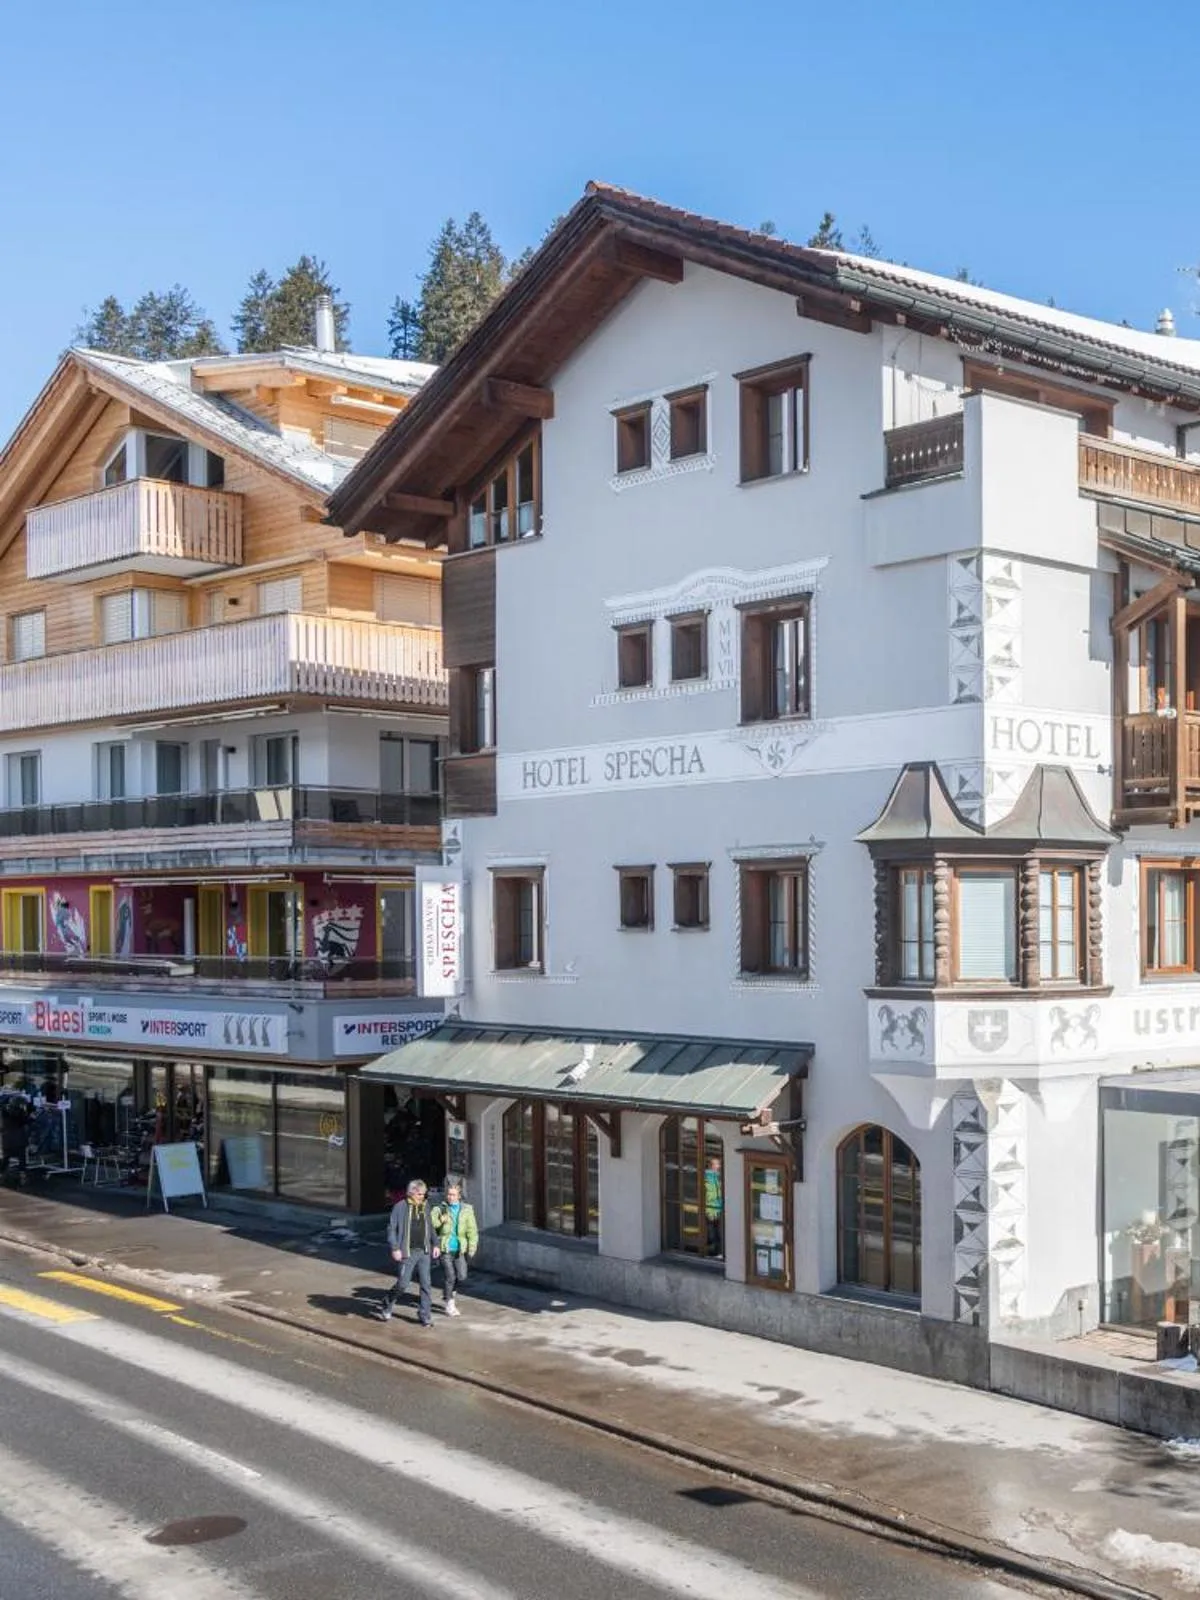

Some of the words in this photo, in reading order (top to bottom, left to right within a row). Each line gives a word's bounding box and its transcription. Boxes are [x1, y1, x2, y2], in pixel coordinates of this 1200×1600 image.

[990, 716, 1101, 759] HOTEL
[522, 756, 591, 790] HOTEL
[604, 744, 705, 782] SPESCHA
[441, 883, 456, 979] SPESCHA
[34, 1001, 85, 1034] Blaesi
[150, 1020, 208, 1037] INTERSPORT
[358, 1020, 440, 1034] INTERSPORT
[381, 1033, 416, 1046] RENT
